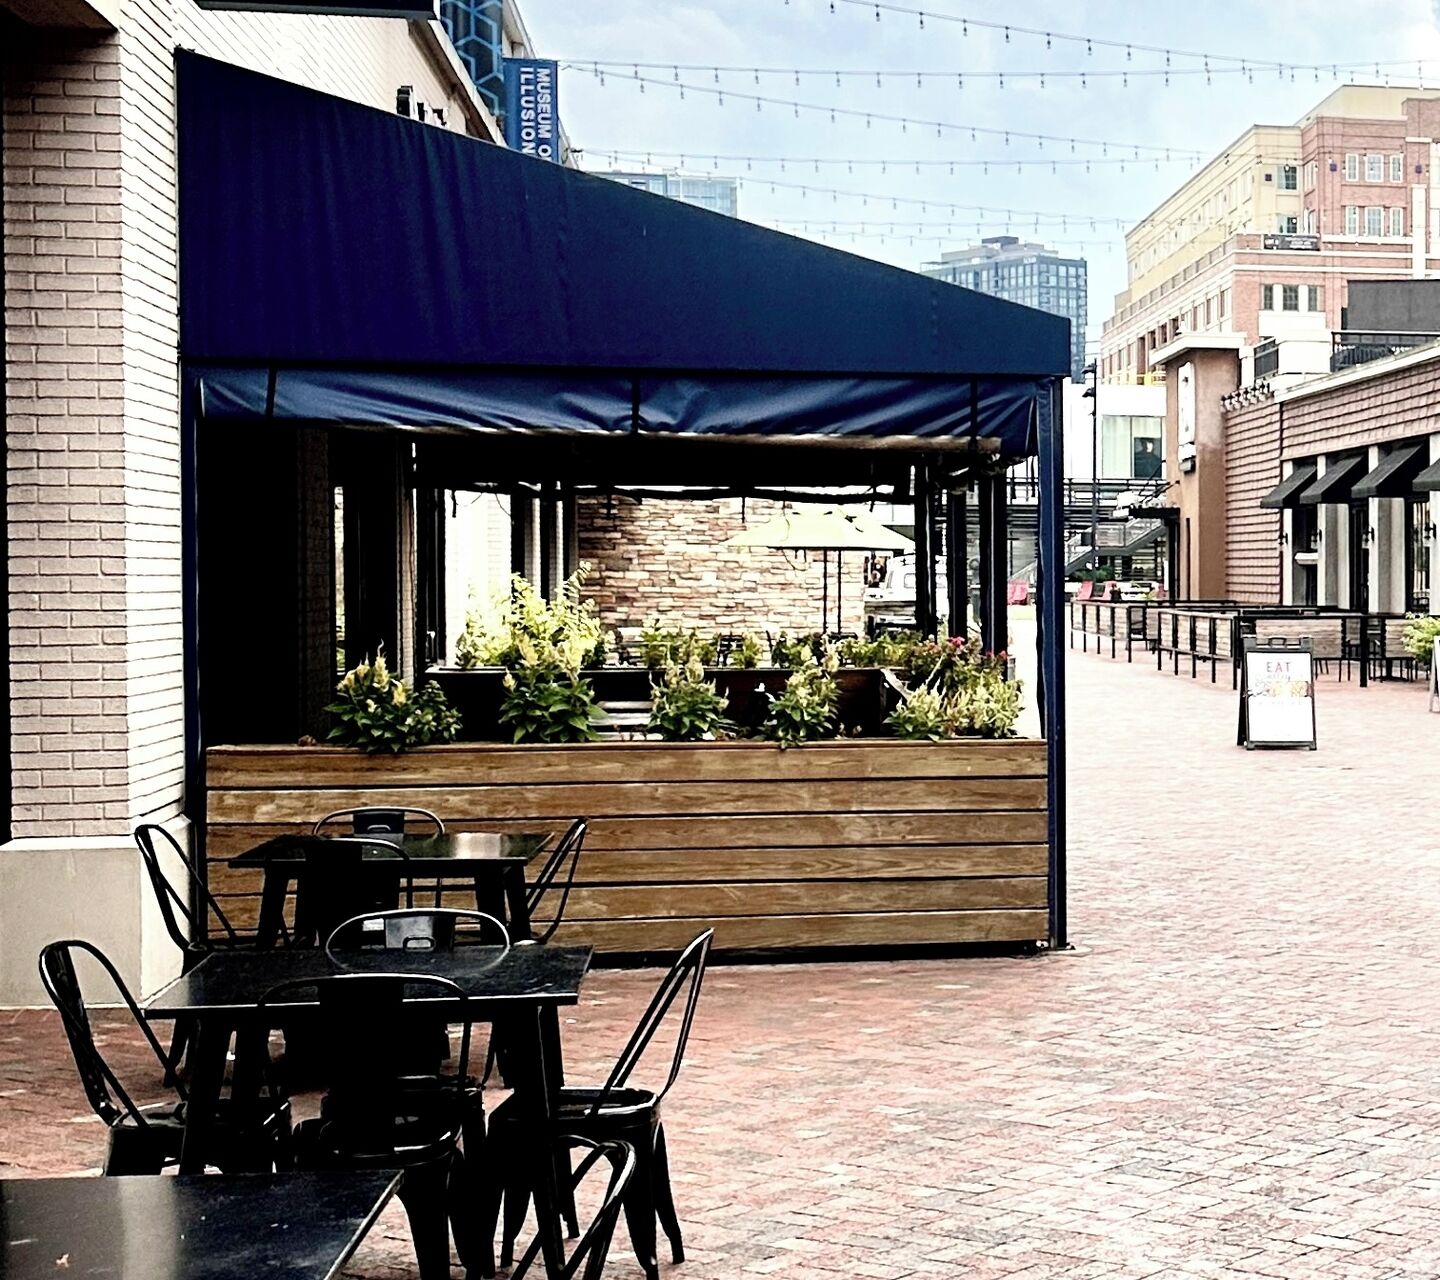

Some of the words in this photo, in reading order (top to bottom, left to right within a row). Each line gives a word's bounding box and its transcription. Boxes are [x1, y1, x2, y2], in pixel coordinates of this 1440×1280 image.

[536, 67, 552, 138] MUSEUM
[537, 144, 553, 161] O
[1266, 661, 1292, 673] EAT
